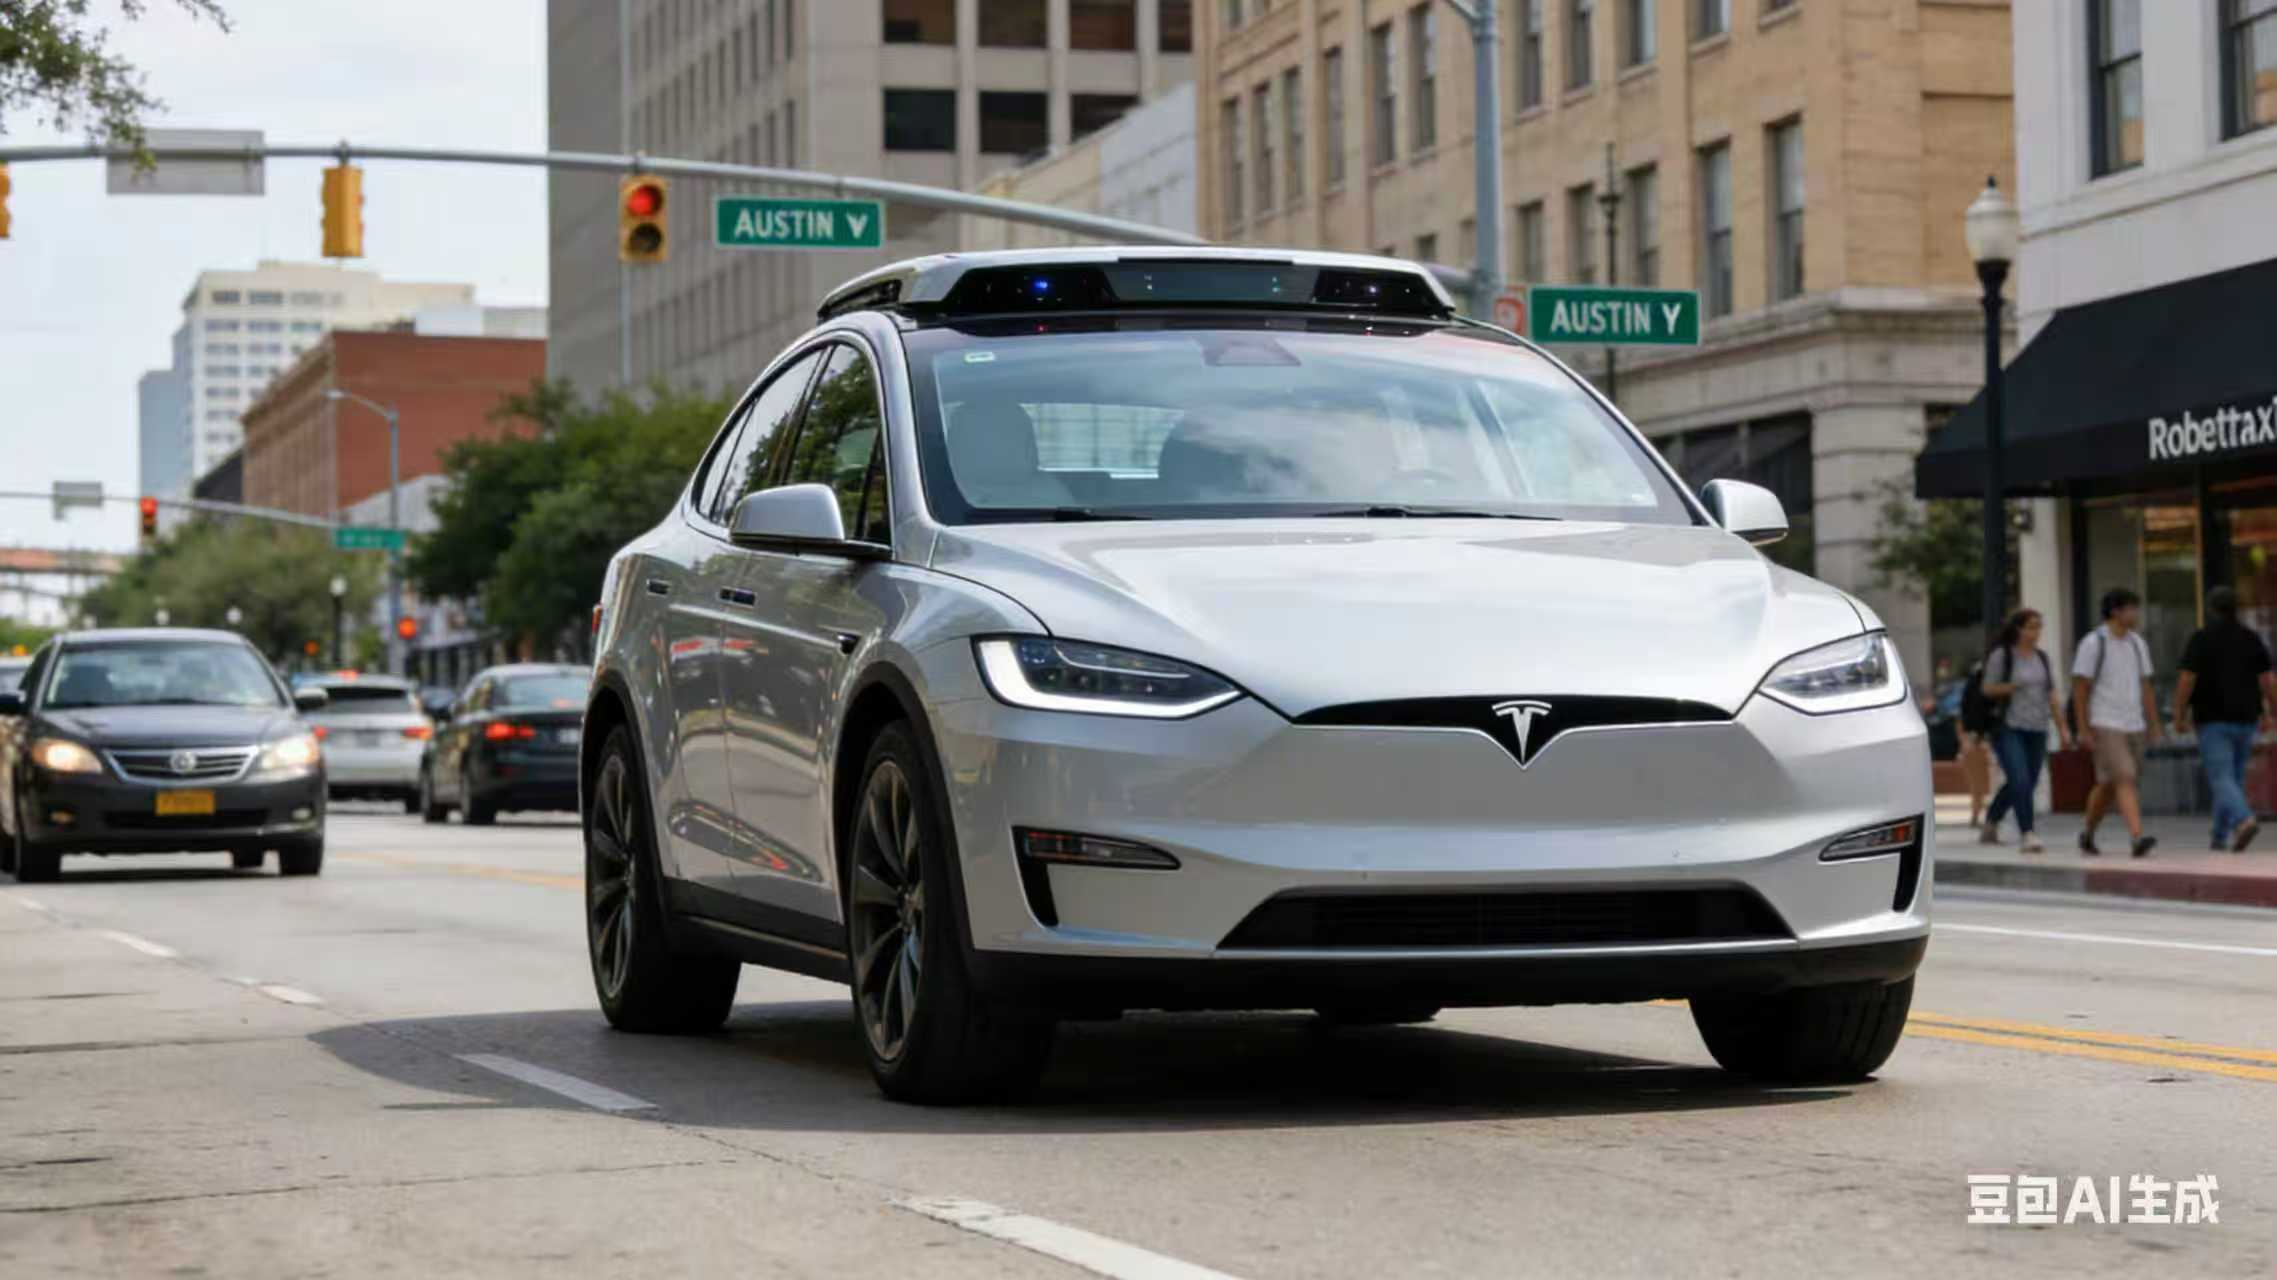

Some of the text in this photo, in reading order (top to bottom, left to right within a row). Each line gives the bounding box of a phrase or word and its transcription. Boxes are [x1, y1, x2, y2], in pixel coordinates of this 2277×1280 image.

[734, 208, 834, 239] AUSTIN
[1551, 300, 1682, 335] AUSTIN Y
